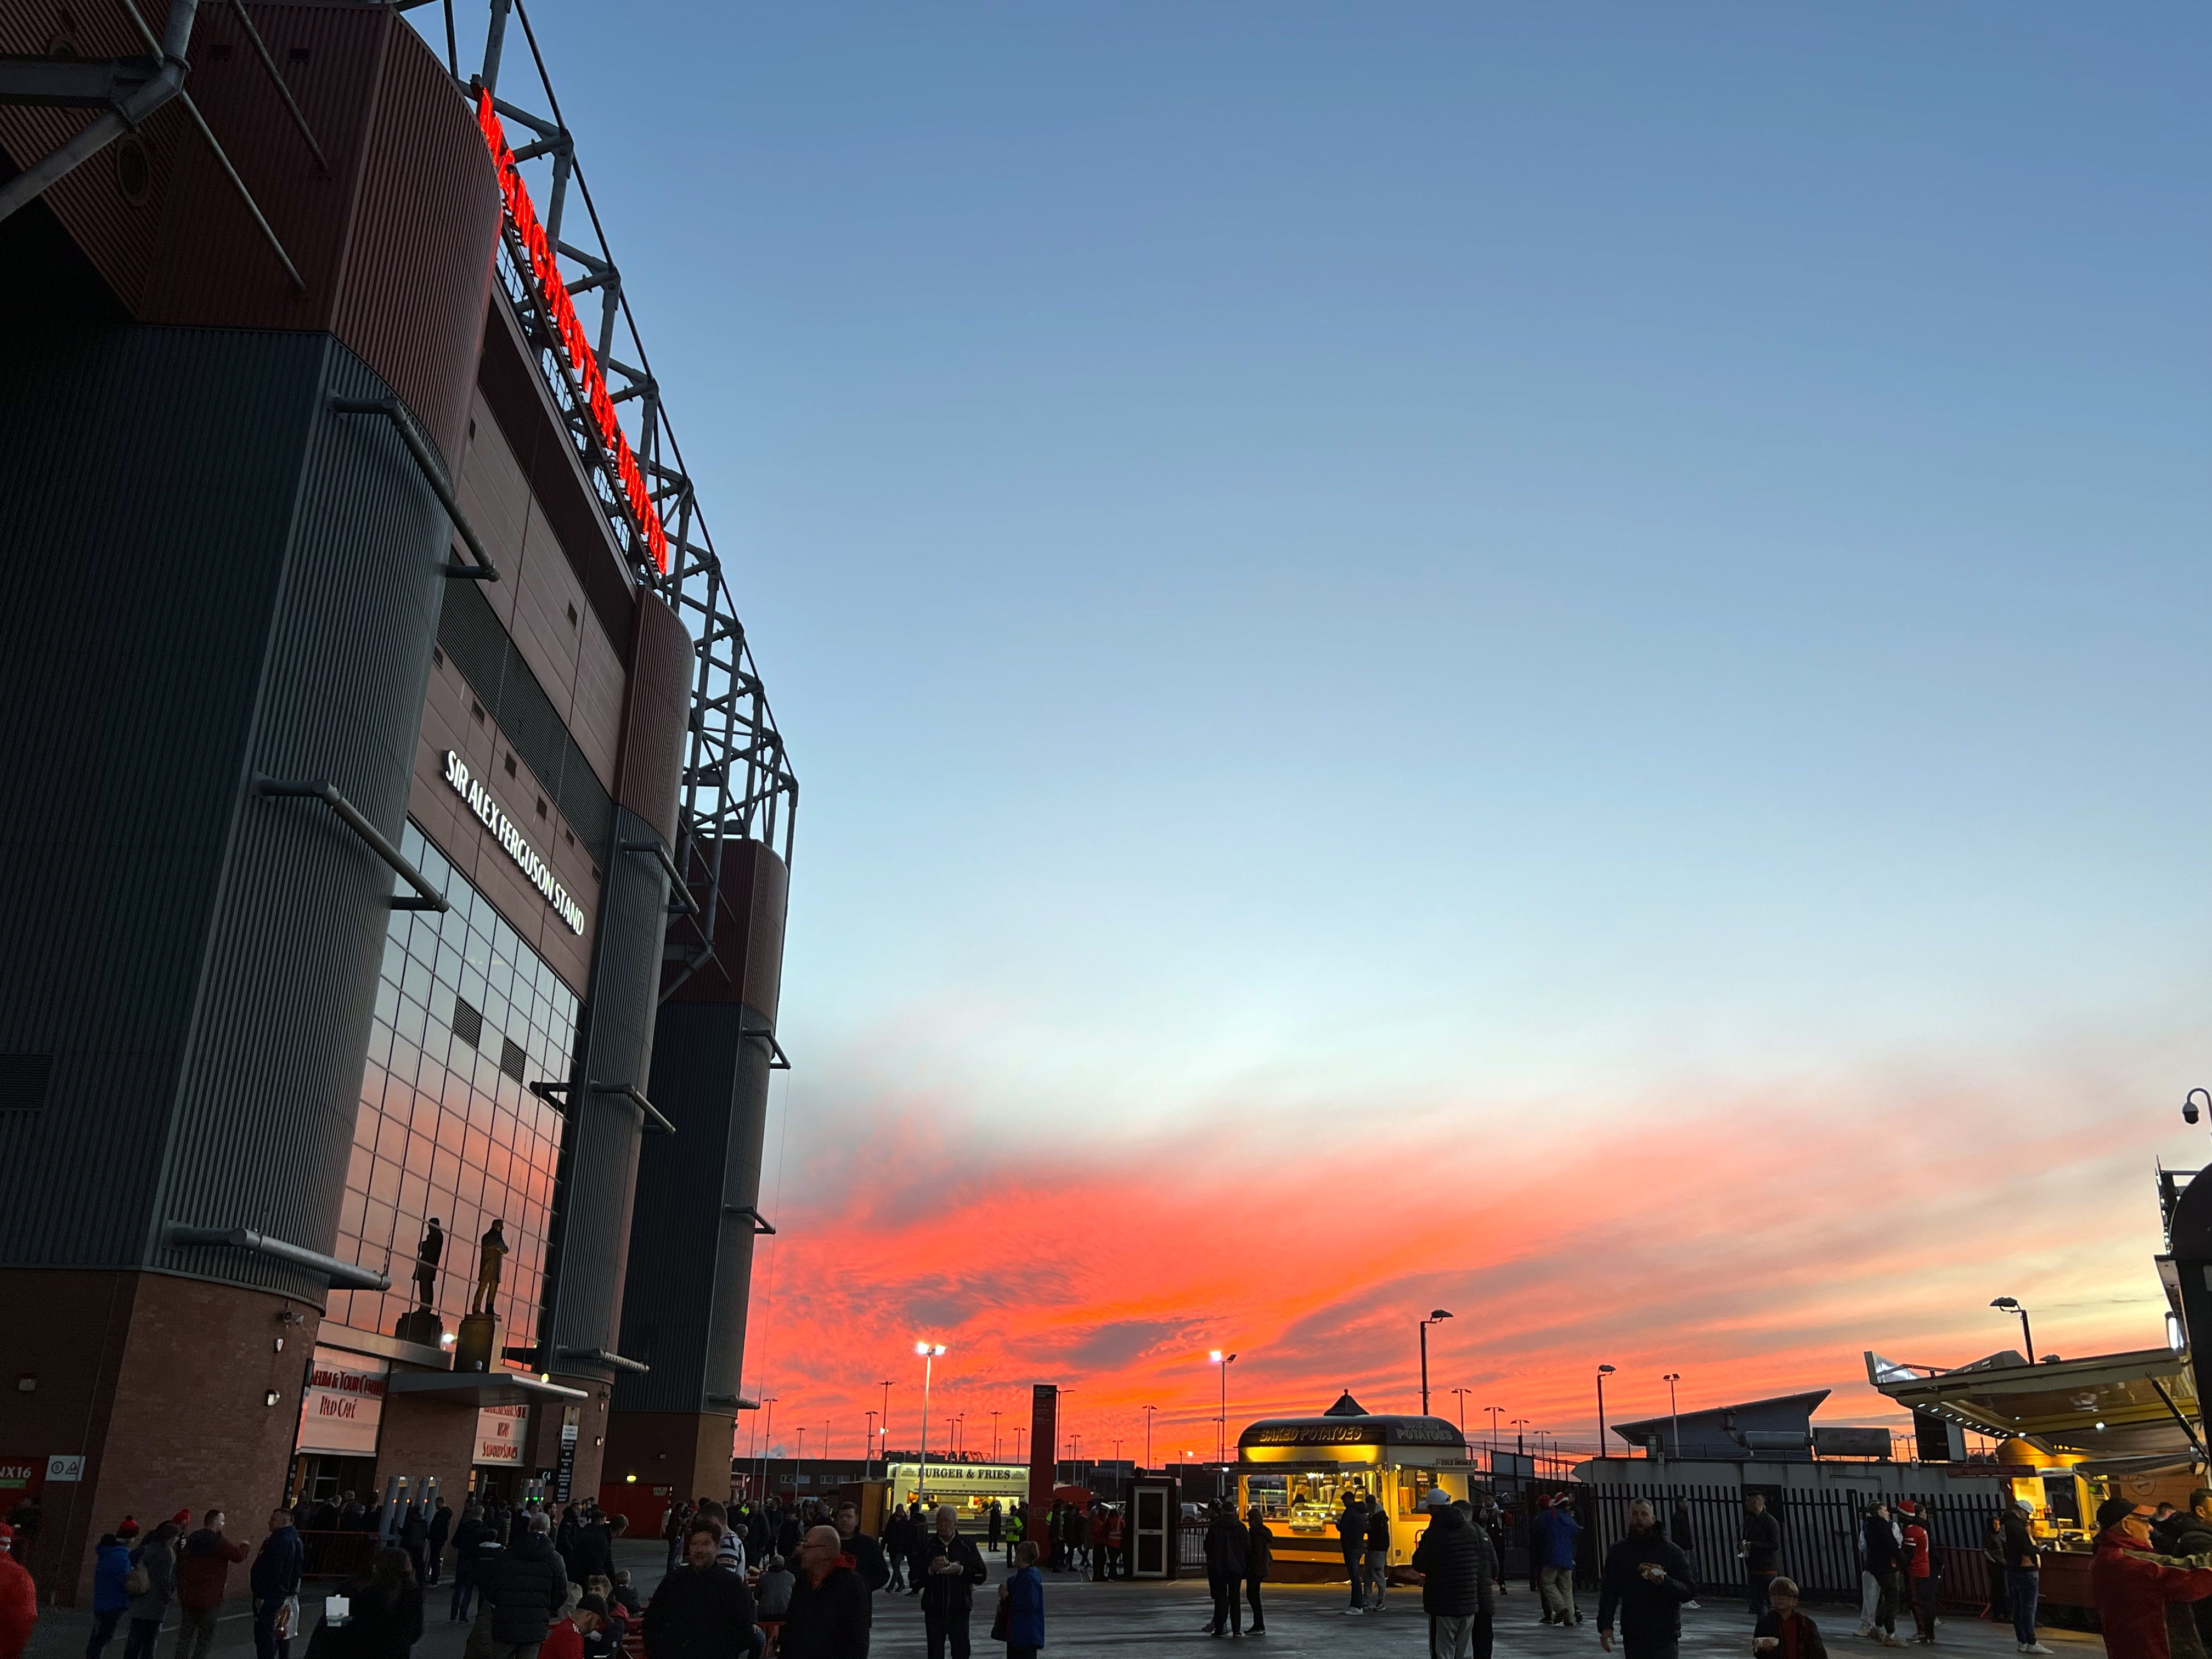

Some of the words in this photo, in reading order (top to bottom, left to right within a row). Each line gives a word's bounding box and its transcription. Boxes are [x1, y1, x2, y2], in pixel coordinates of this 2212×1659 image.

[445, 749, 469, 798] SIR
[467, 778, 500, 836] ALEX
[498, 814, 555, 901] FERGUSON
[553, 883, 584, 936] STAND
[1259, 1426, 1299, 1442] BAKED
[1299, 1425, 1363, 1441] POTATOES
[1395, 1427, 1453, 1441] POTATOES
[966, 1469, 975, 1479] &
[978, 1469, 1011, 1480] FRIES
